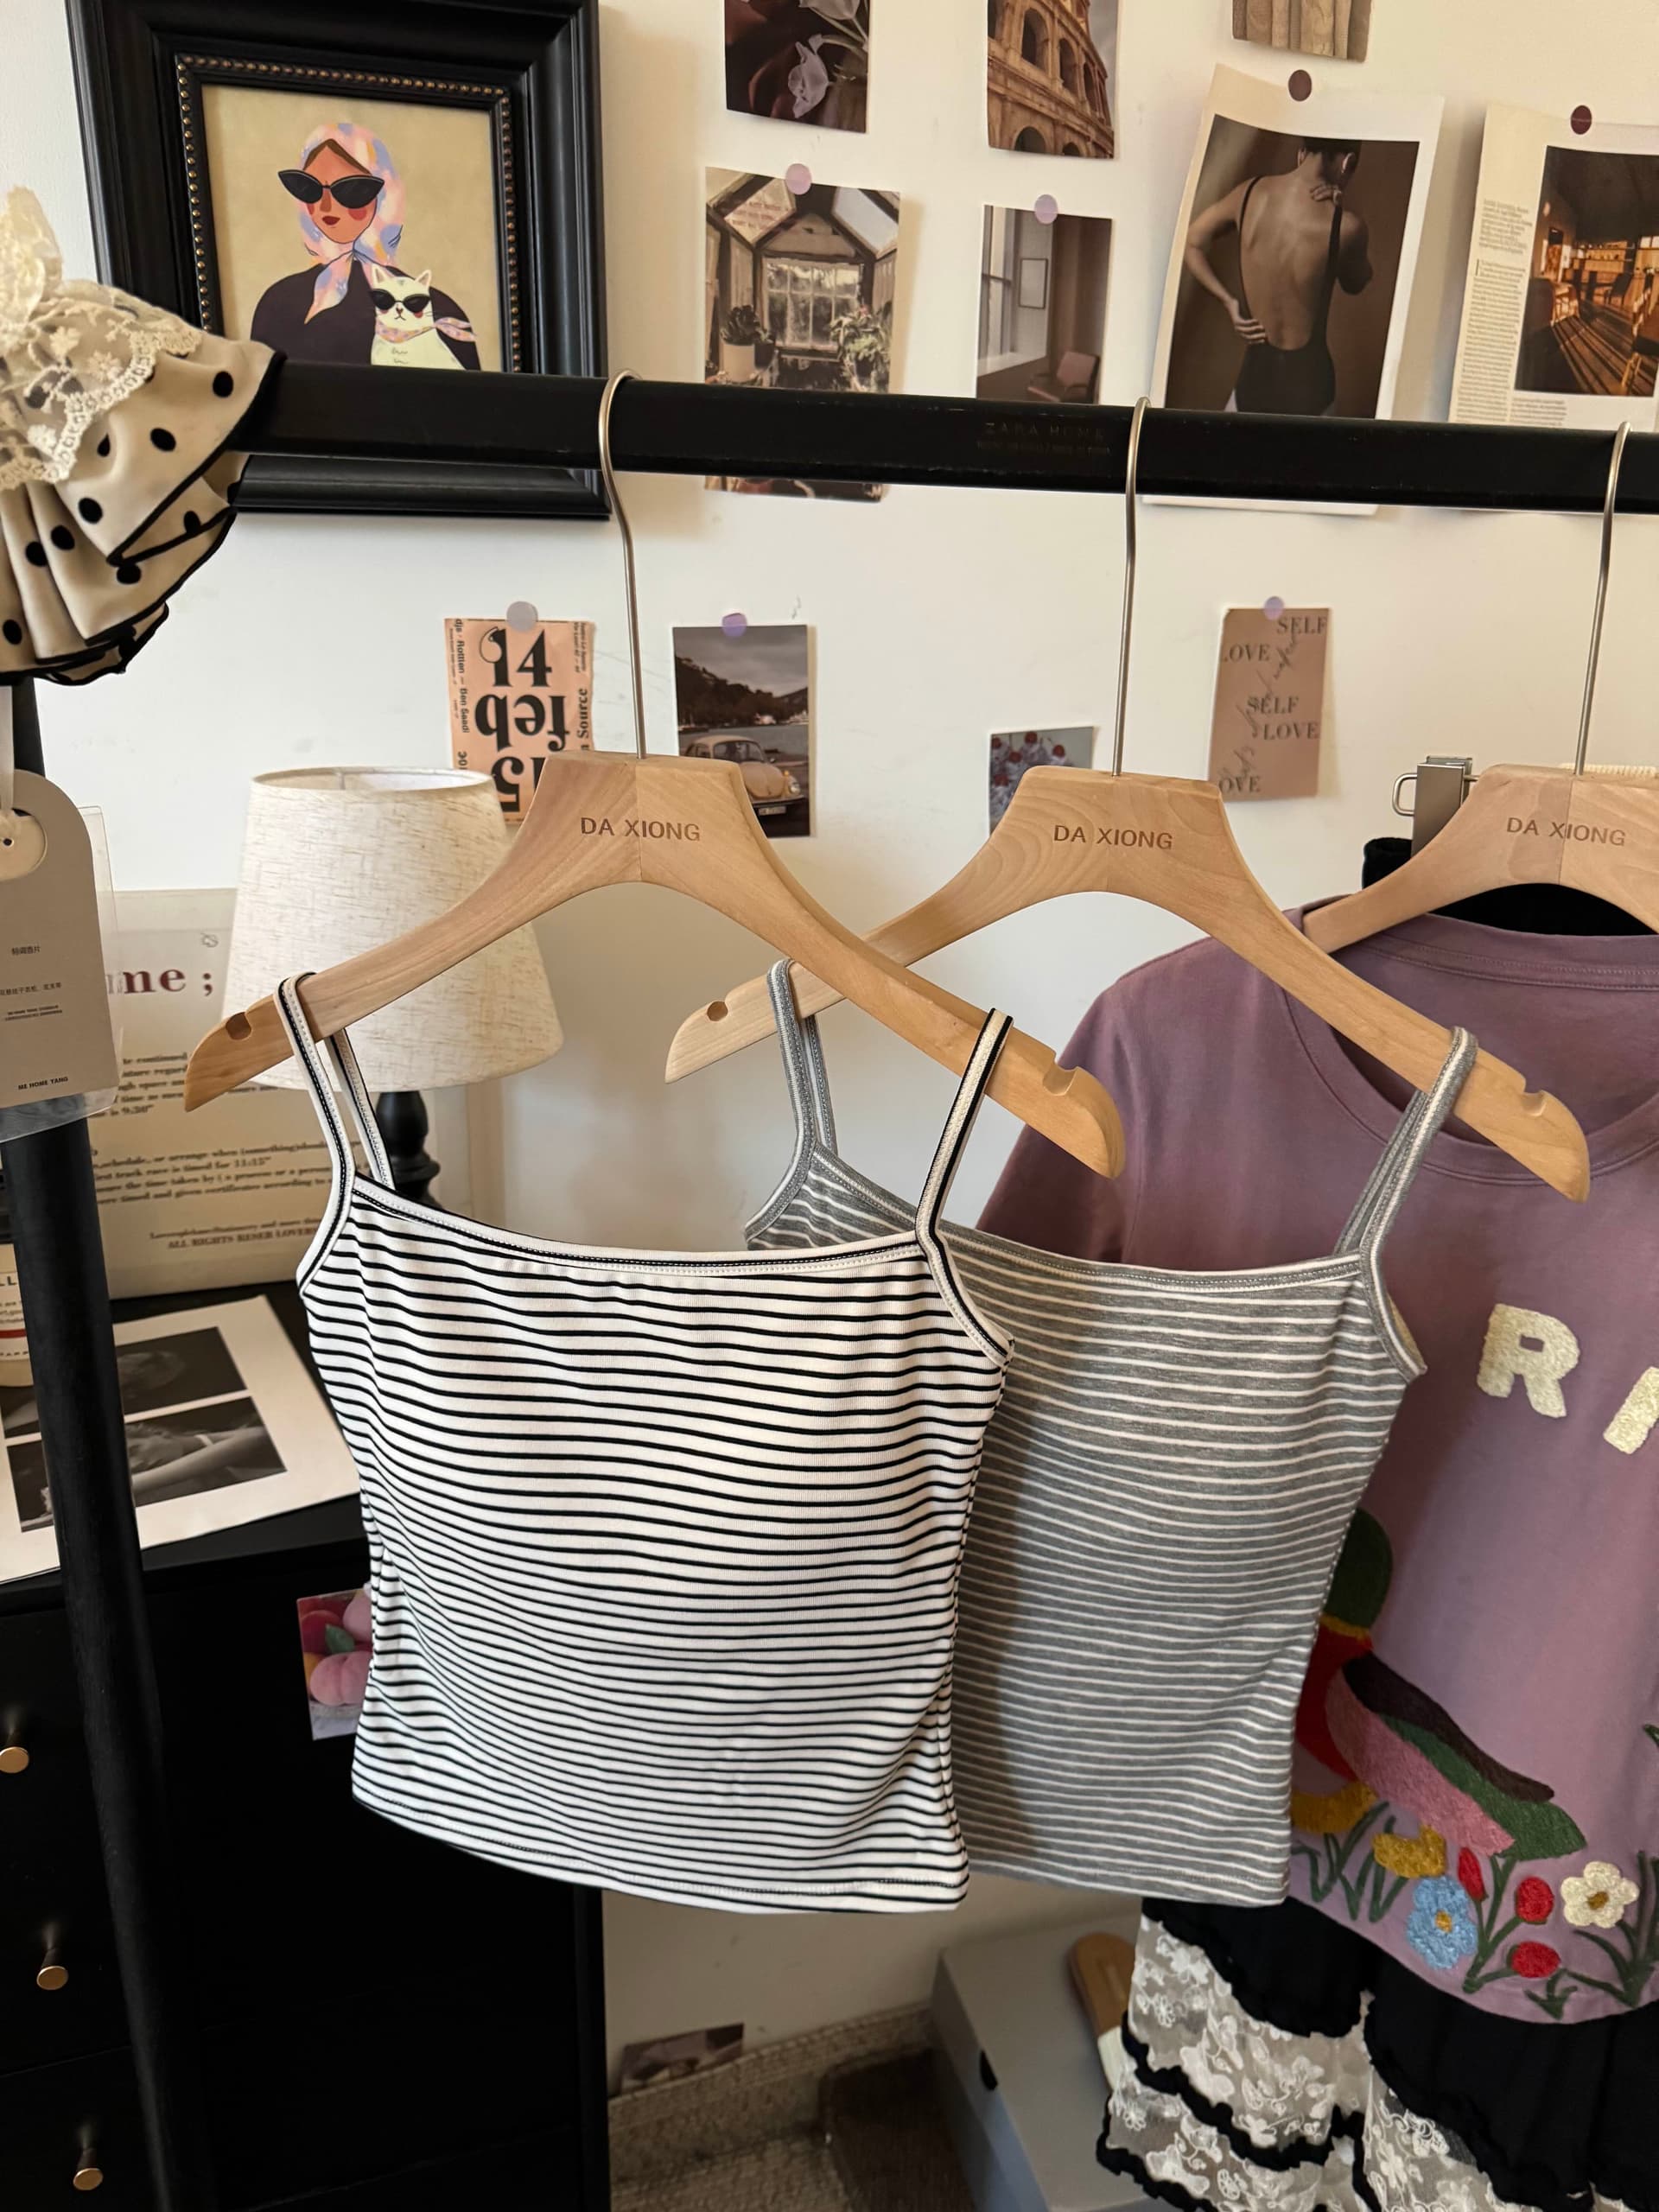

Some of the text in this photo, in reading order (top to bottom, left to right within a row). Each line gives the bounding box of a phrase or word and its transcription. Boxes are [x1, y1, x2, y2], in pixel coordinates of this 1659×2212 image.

[1277, 616, 1327, 634] SELF
[479, 626, 553, 688] 14
[1245, 696, 1300, 715] SELF
[475, 694, 570, 753] feb
[1263, 722, 1321, 741] LOVE
[1217, 776, 1262, 794] OVE
[581, 817, 701, 842] DA XIONG
[1053, 824, 1173, 850] DA XIONG
[1506, 817, 1626, 848] DA XIONG
